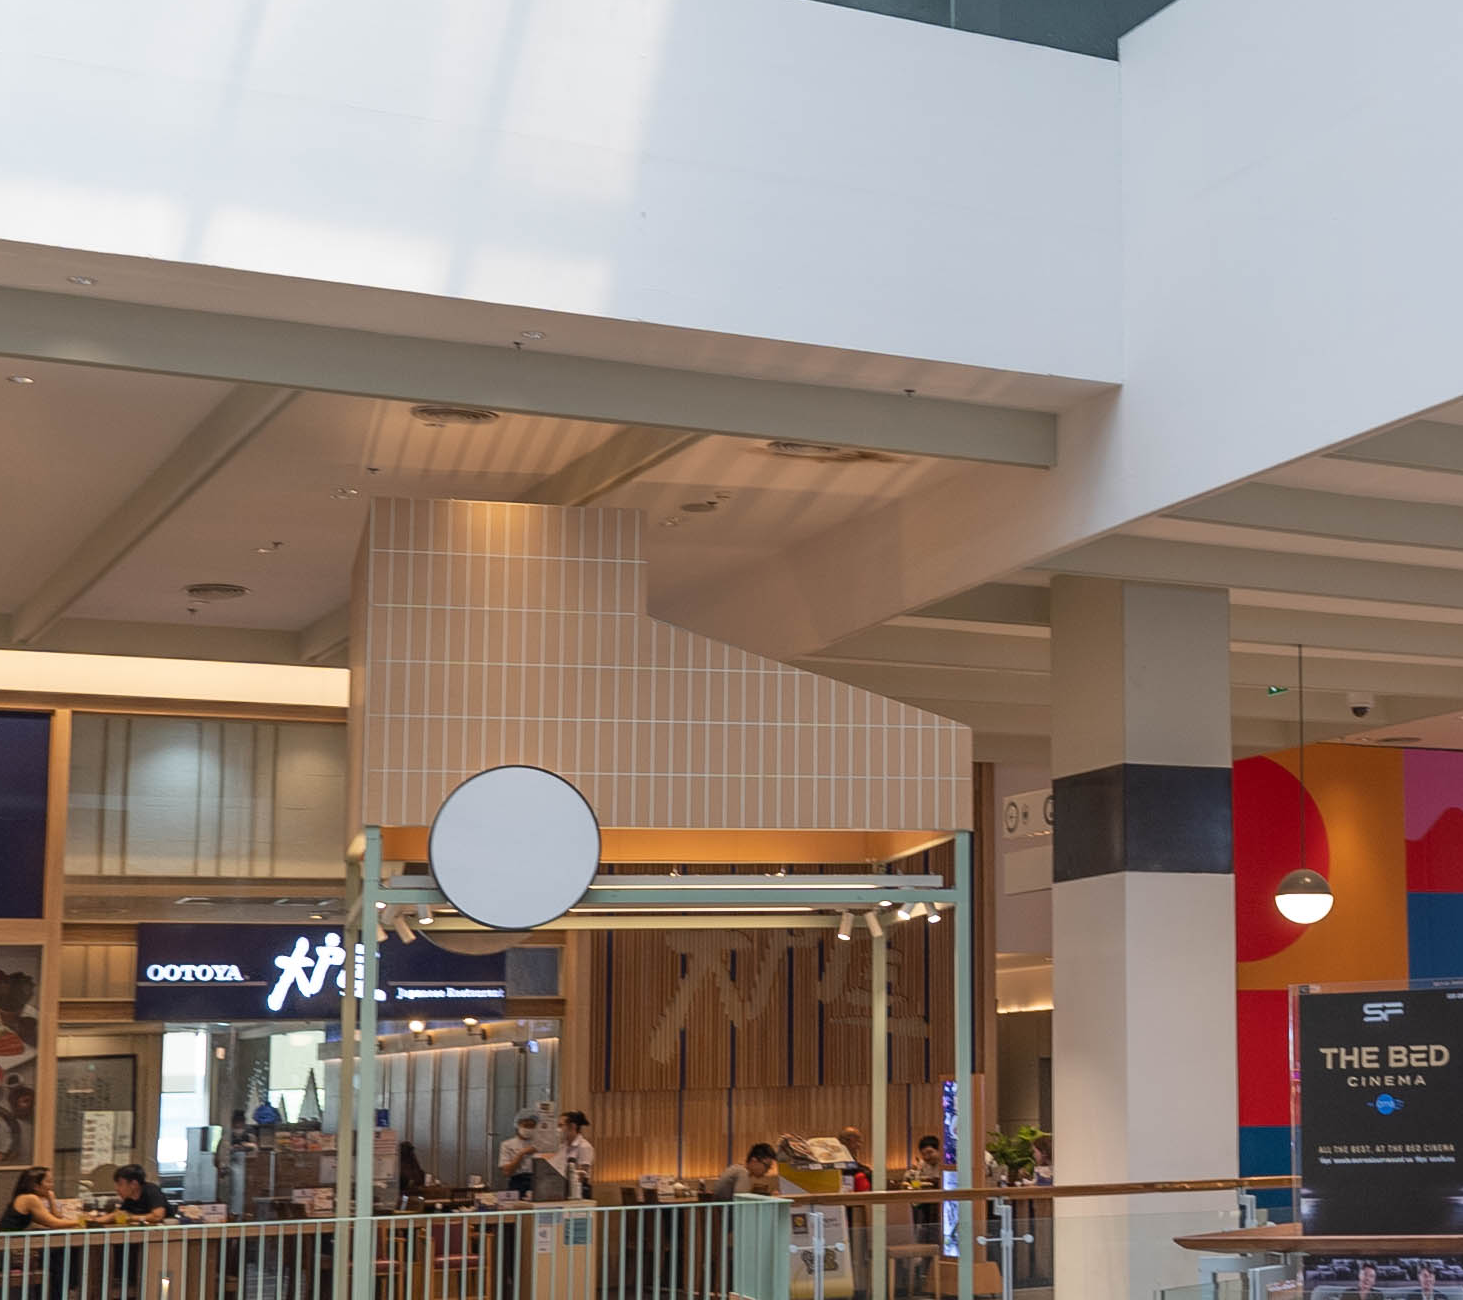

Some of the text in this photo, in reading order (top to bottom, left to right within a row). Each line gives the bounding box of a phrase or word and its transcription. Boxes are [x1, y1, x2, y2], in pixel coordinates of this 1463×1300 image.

[147, 964, 244, 981] OOTOYA
[396, 986, 505, 1000] Japanese Restaurant
[1362, 1002, 1405, 1022] SF
[1319, 1045, 1450, 1069] THE BED
[1347, 1075, 1426, 1087] CINEMA
[1318, 1145, 1332, 1154] ALL
[1334, 1145, 1349, 1154] THE
[1375, 1145, 1386, 1153] AT
